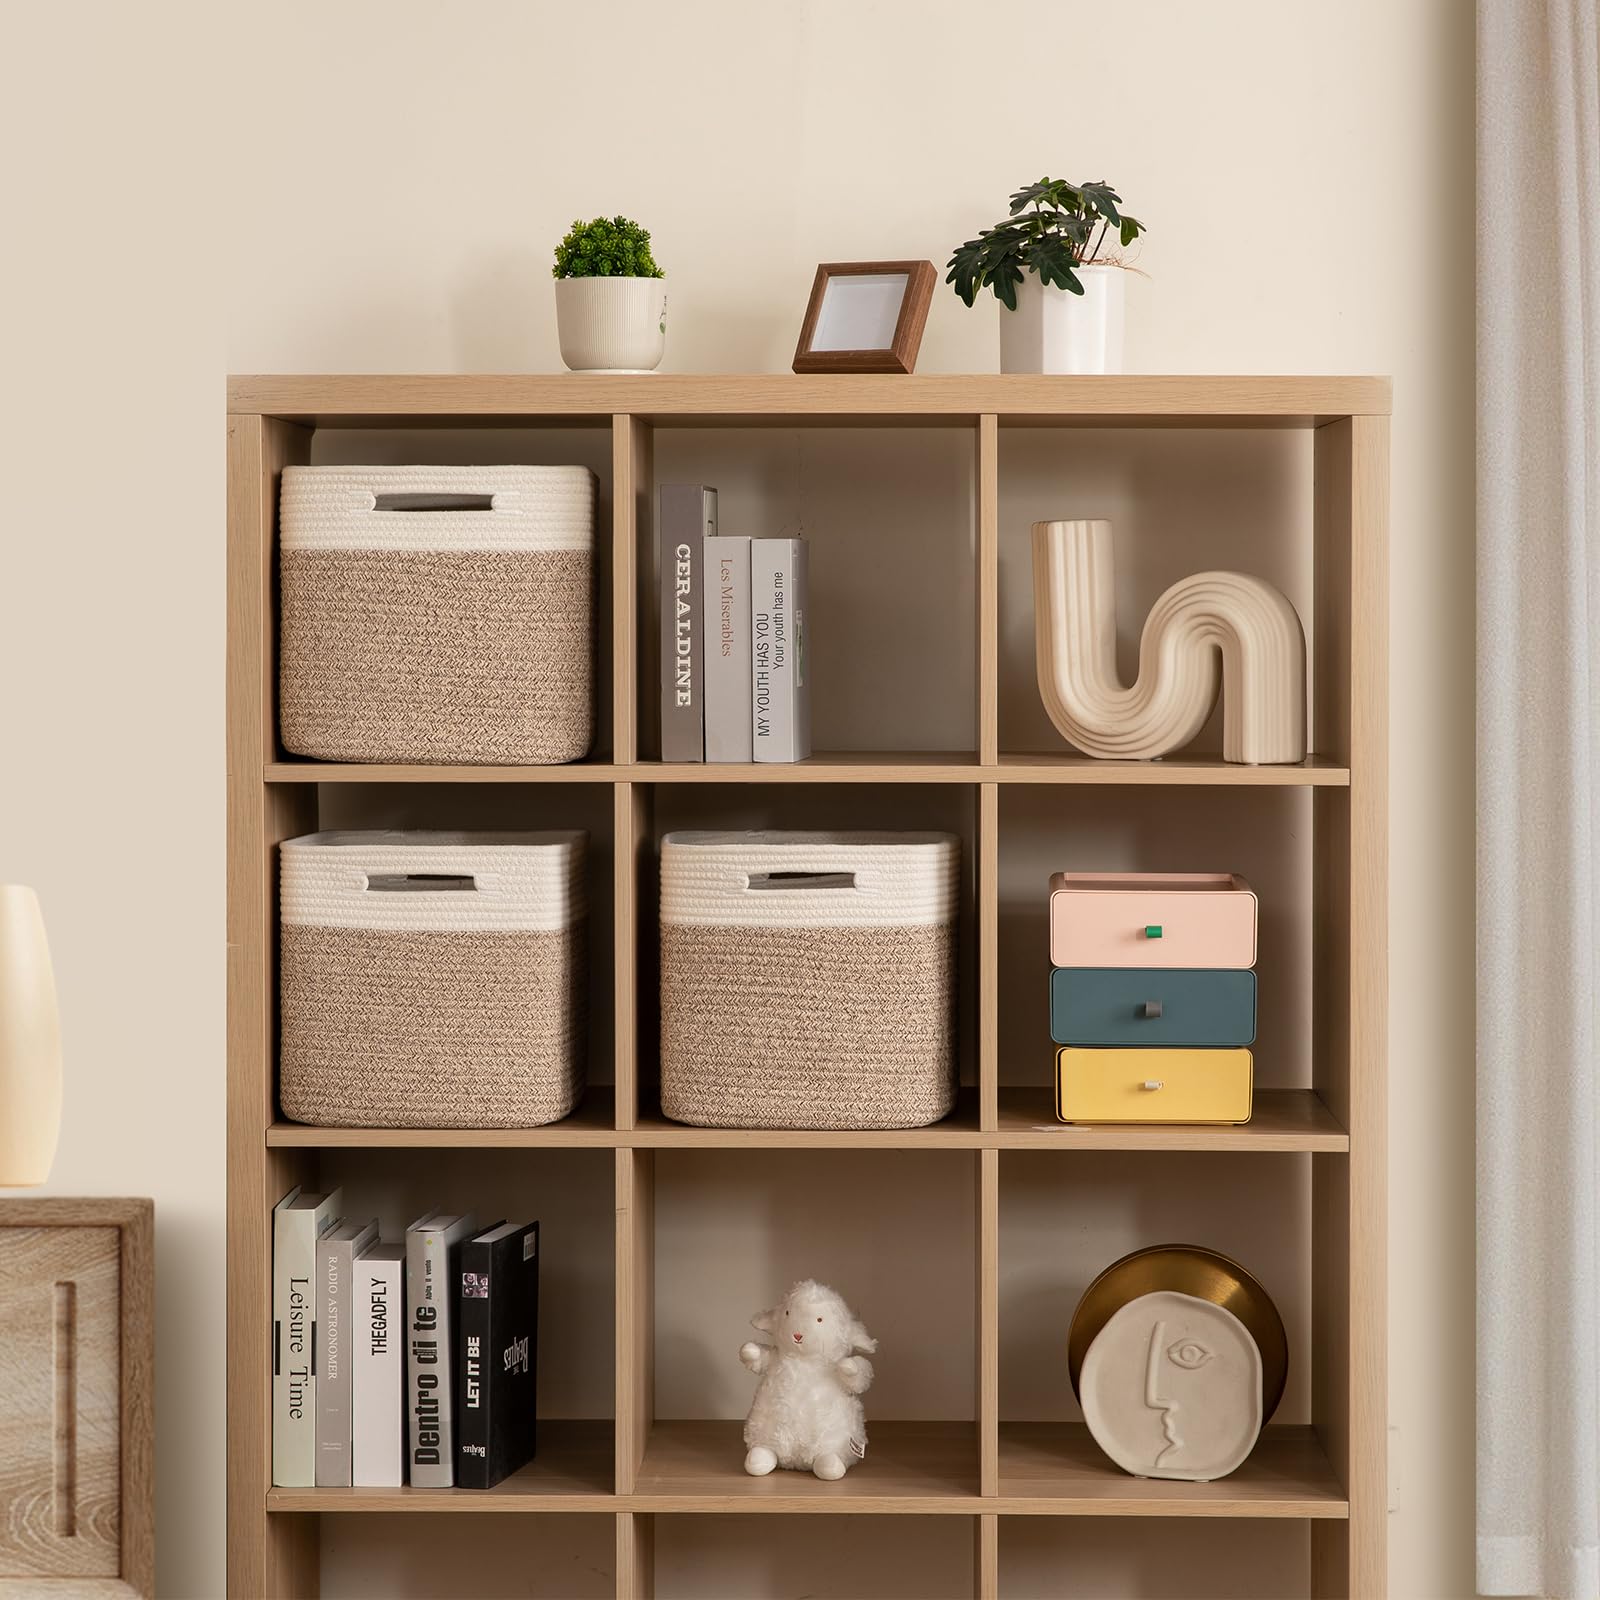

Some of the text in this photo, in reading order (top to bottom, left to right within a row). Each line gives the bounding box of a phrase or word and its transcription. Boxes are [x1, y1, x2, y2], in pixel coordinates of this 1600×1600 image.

[721, 559, 735, 657] Les Miserables
[773, 571, 786, 670] Your youth has me
[757, 613, 770, 737] MY YOUTH HAS YOU
[290, 1277, 308, 1420] Leisure Time
[328, 1256, 338, 1380] RADIO ASTRONOMER
[371, 1278, 386, 1356] THEGADFLY
[467, 1337, 480, 1408] LET IT BE
[413, 1306, 440, 1465] Dentro di te
